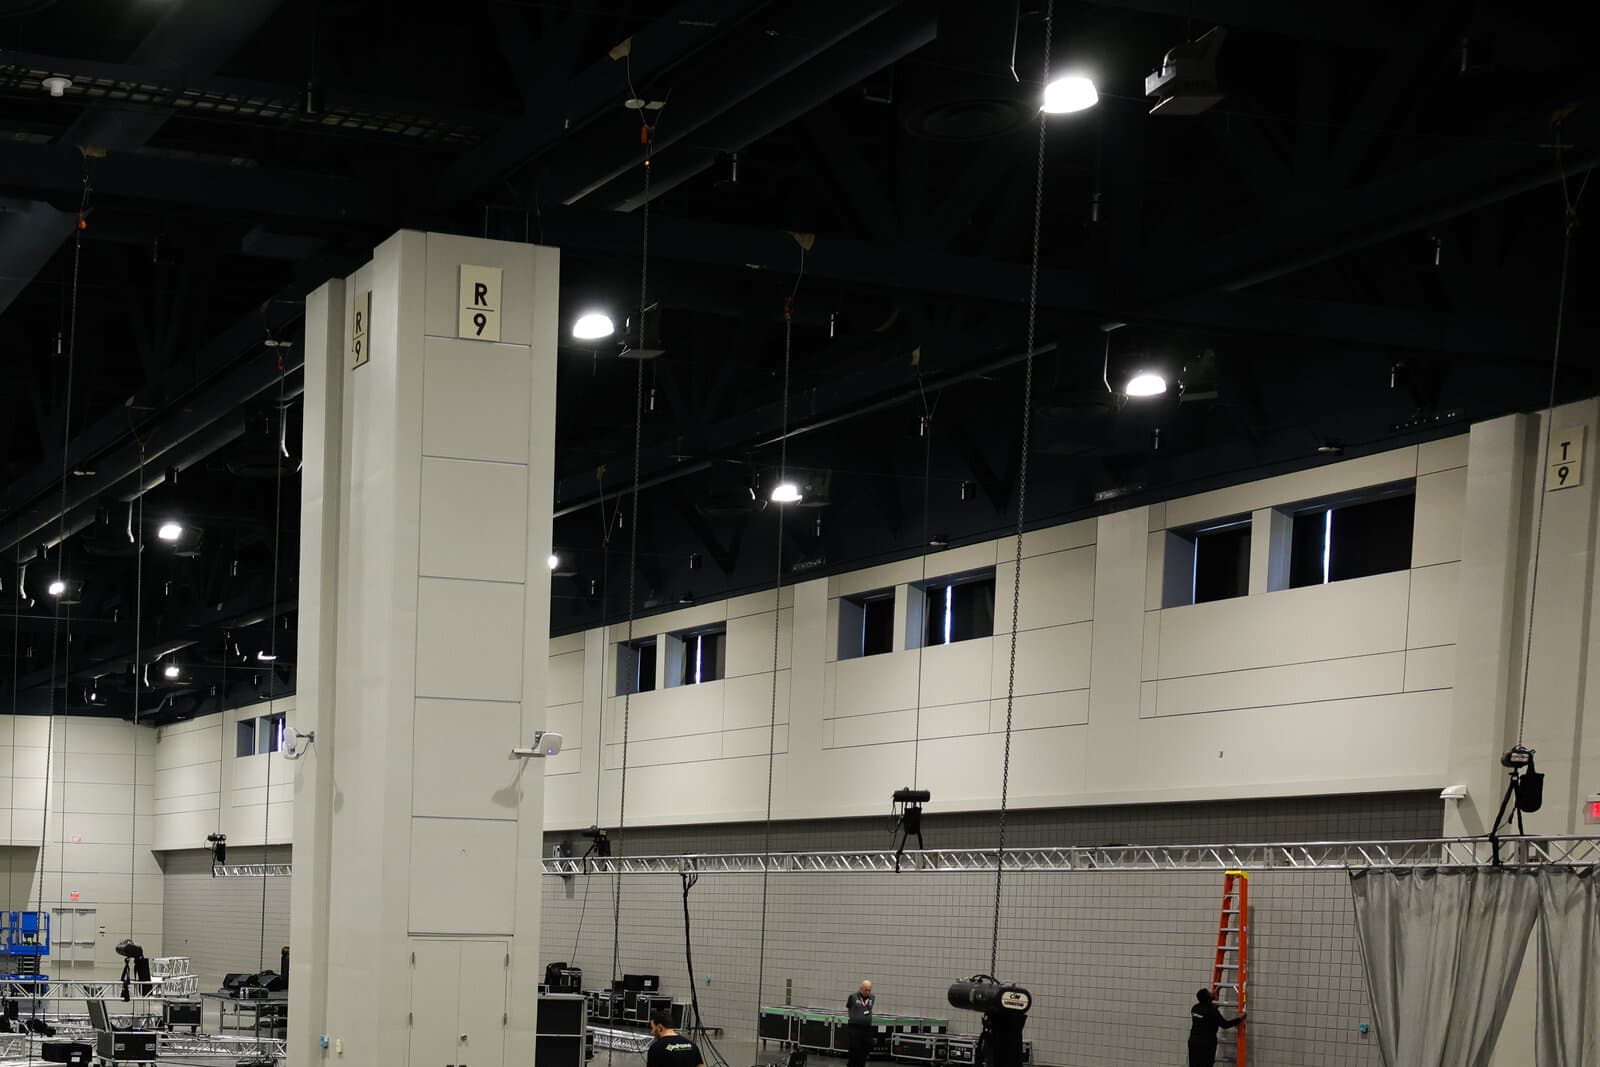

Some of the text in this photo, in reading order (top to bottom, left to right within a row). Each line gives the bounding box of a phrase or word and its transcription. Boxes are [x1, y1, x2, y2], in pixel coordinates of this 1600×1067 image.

[474, 282, 488, 307] R
[355, 311, 362, 335] R
[473, 313, 487, 336] 9
[354, 340, 361, 363] 9
[1561, 441, 1571, 461] T
[1558, 466, 1569, 485] 9
